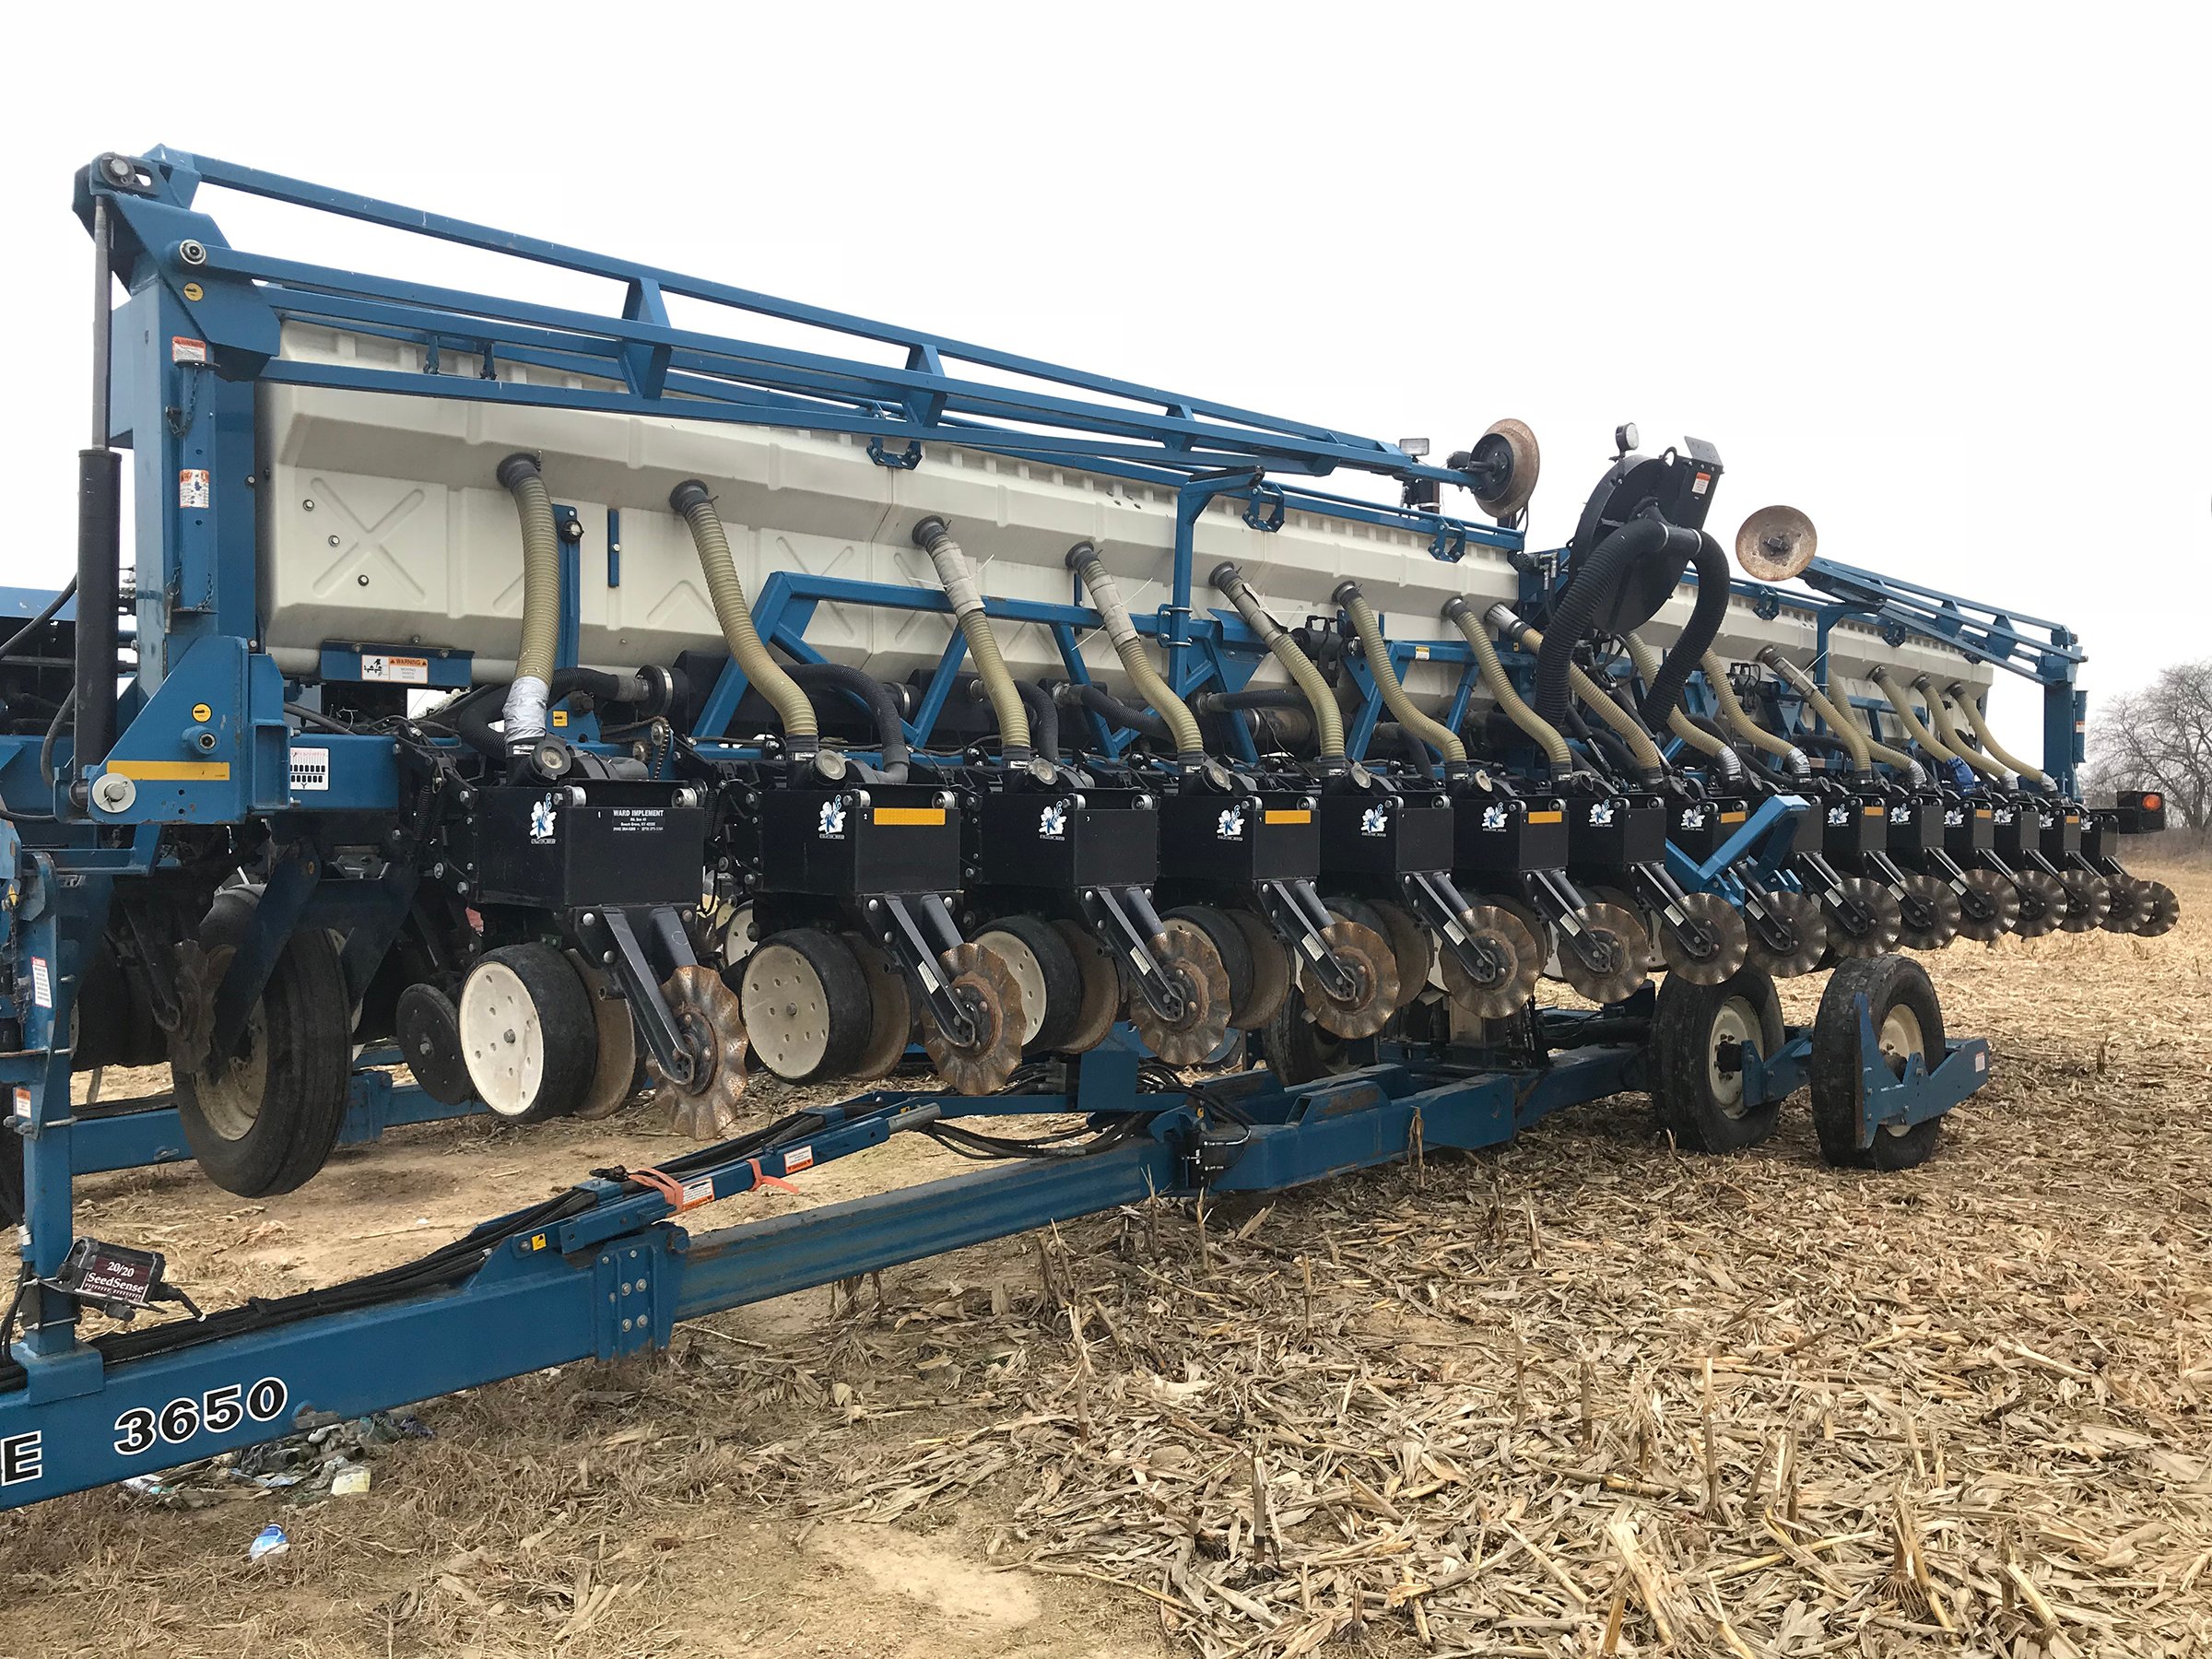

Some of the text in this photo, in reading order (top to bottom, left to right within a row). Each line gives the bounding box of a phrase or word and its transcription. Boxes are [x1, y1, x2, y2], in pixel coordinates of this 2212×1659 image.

[395, 657, 422, 665] WARNING
[107, 1261, 135, 1277] 20/20
[87, 1272, 144, 1294] SeedSense
[113, 1376, 288, 1455] 3650
